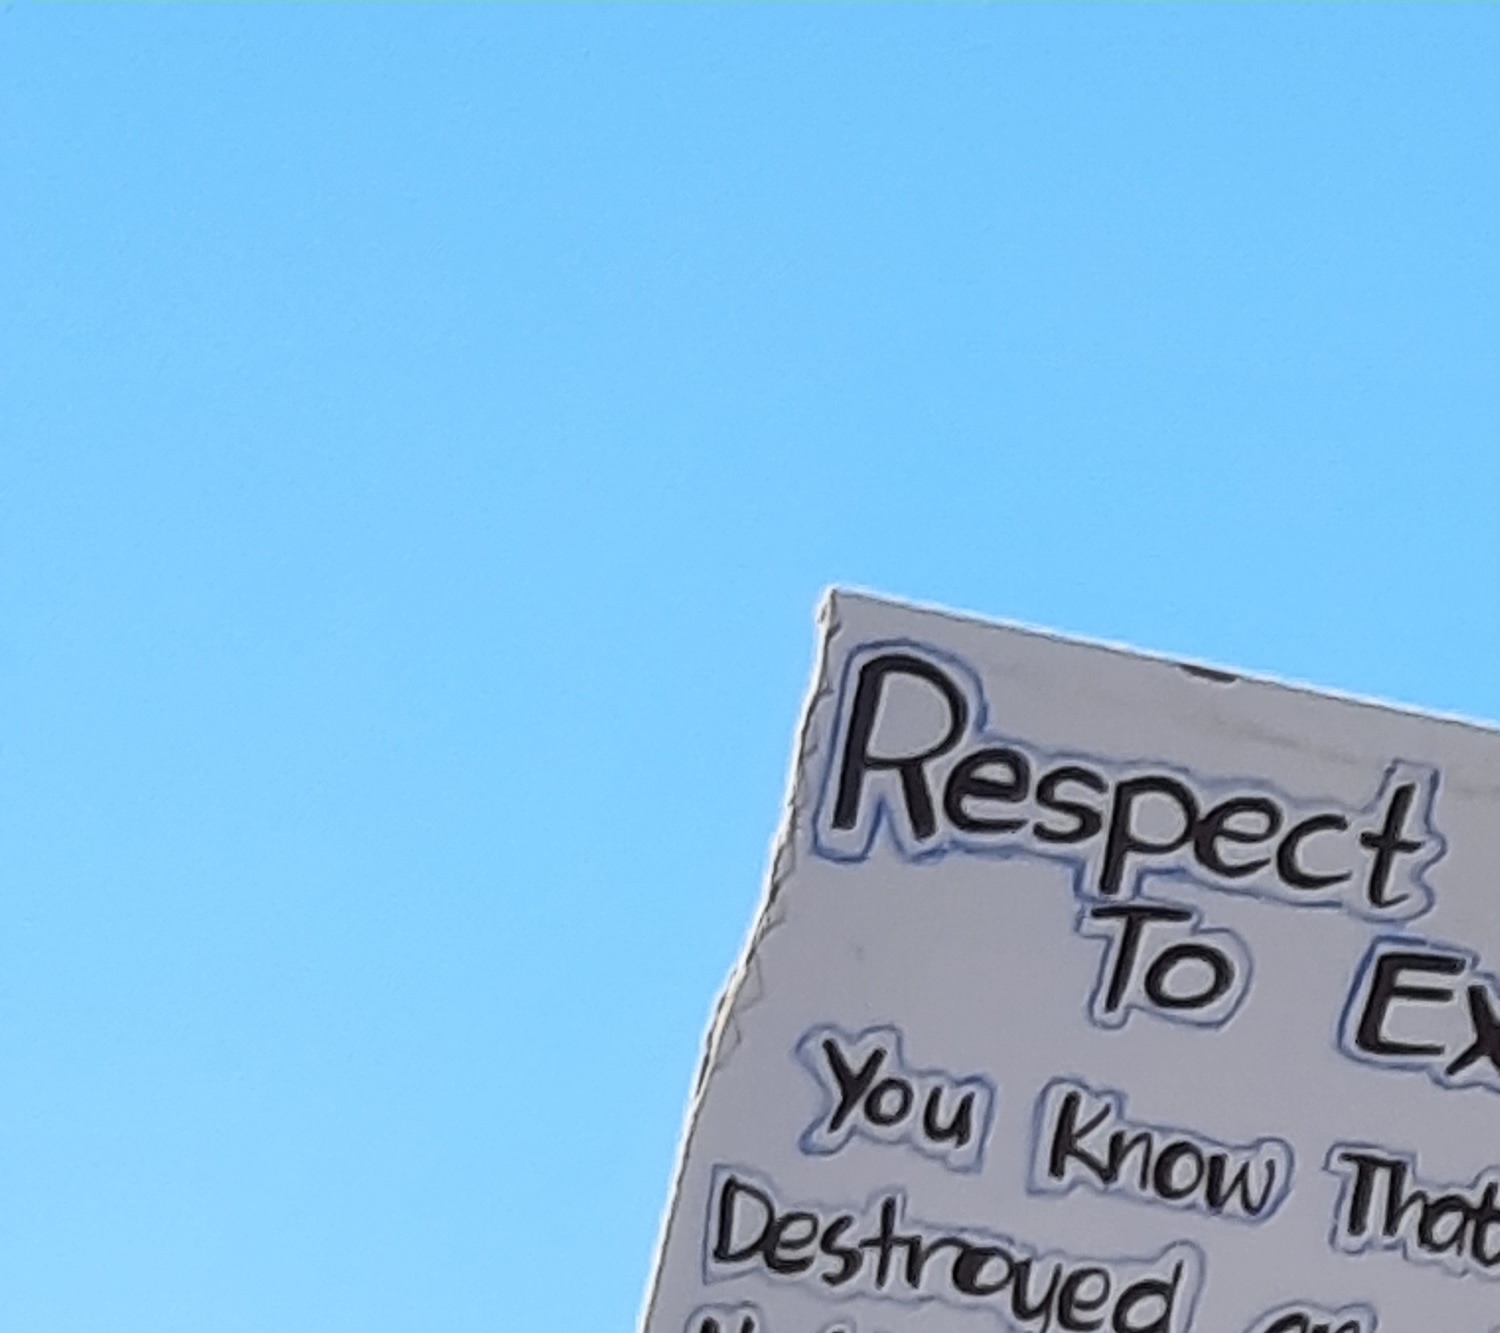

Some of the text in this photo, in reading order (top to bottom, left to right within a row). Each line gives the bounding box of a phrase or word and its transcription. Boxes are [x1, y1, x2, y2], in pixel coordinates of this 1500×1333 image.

[830, 653, 1423, 908] Respect
[1089, 903, 1235, 1013] To
[821, 1038, 974, 1147] You
[1048, 1090, 1276, 1215] Know
